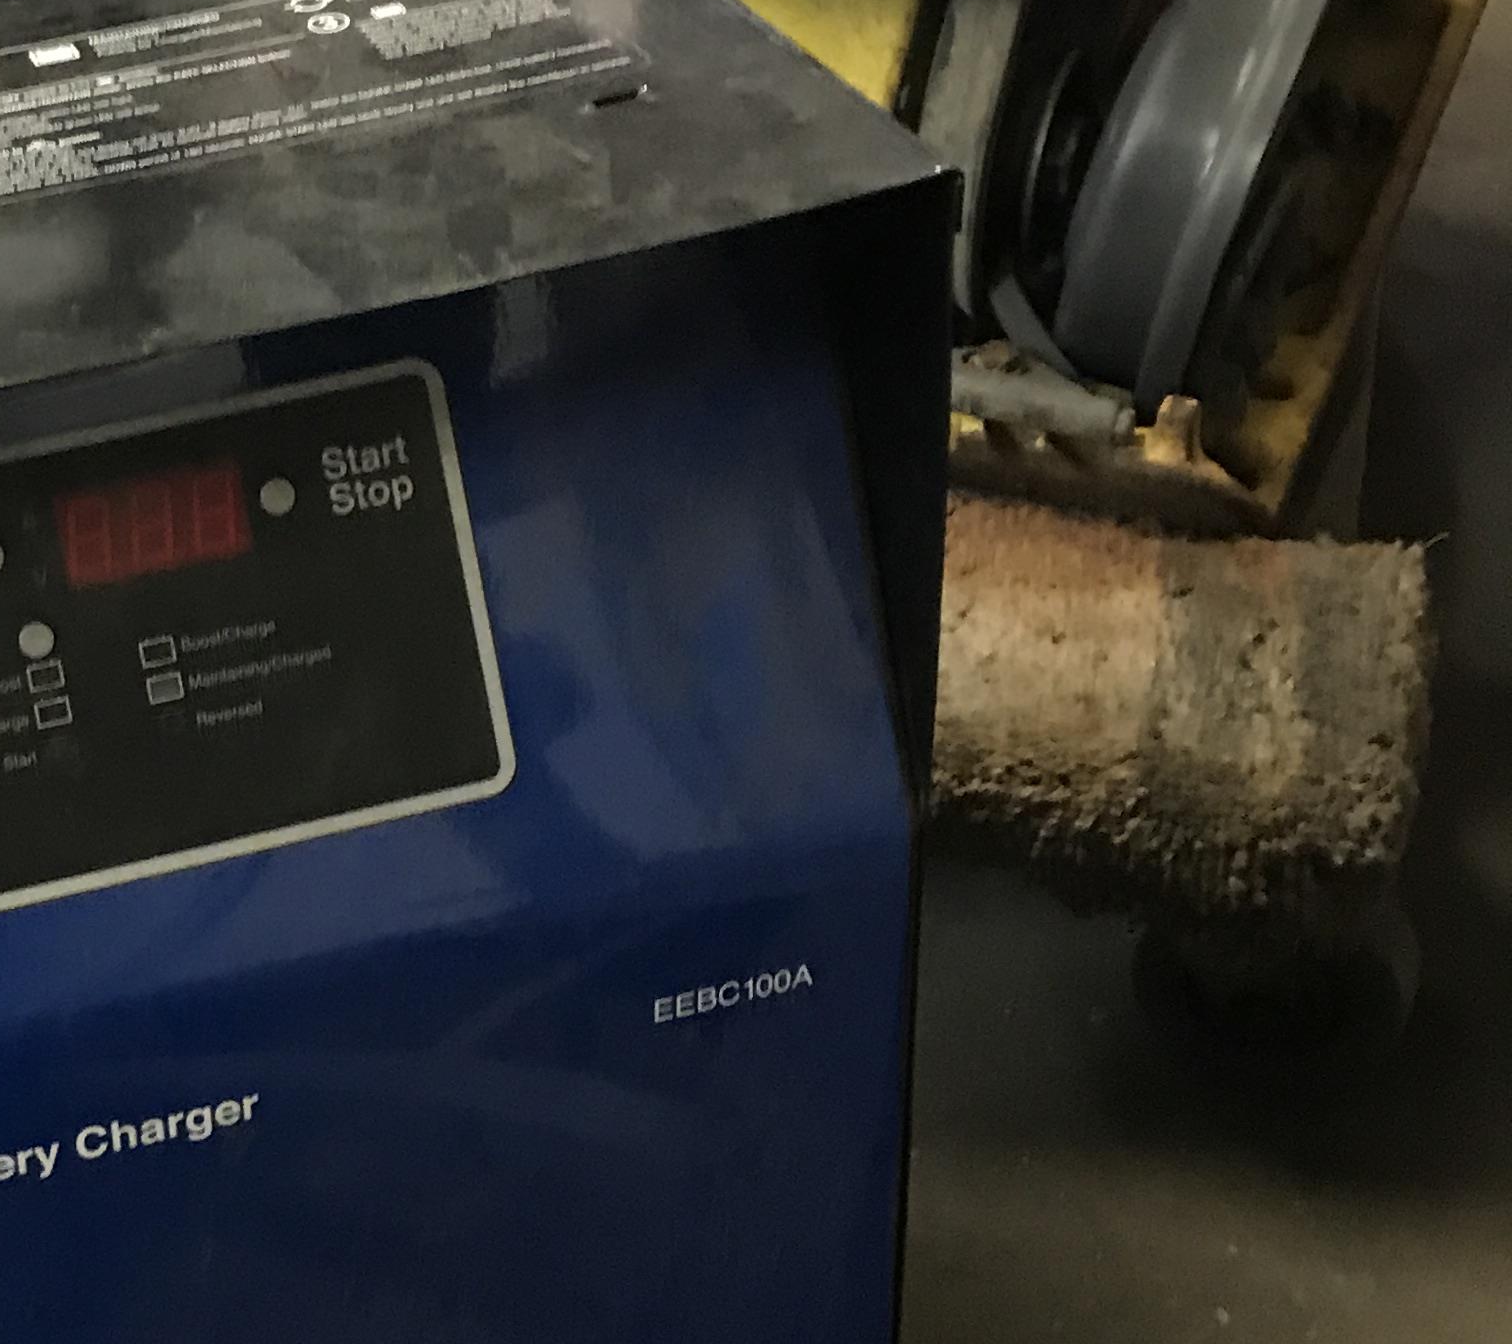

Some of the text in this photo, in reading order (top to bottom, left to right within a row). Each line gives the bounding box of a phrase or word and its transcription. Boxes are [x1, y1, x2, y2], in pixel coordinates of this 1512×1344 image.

[320, 433, 410, 481] Start
[328, 473, 415, 516] Stop
[653, 963, 814, 1024] EEBC100A
[73, 1092, 260, 1160] Charger
